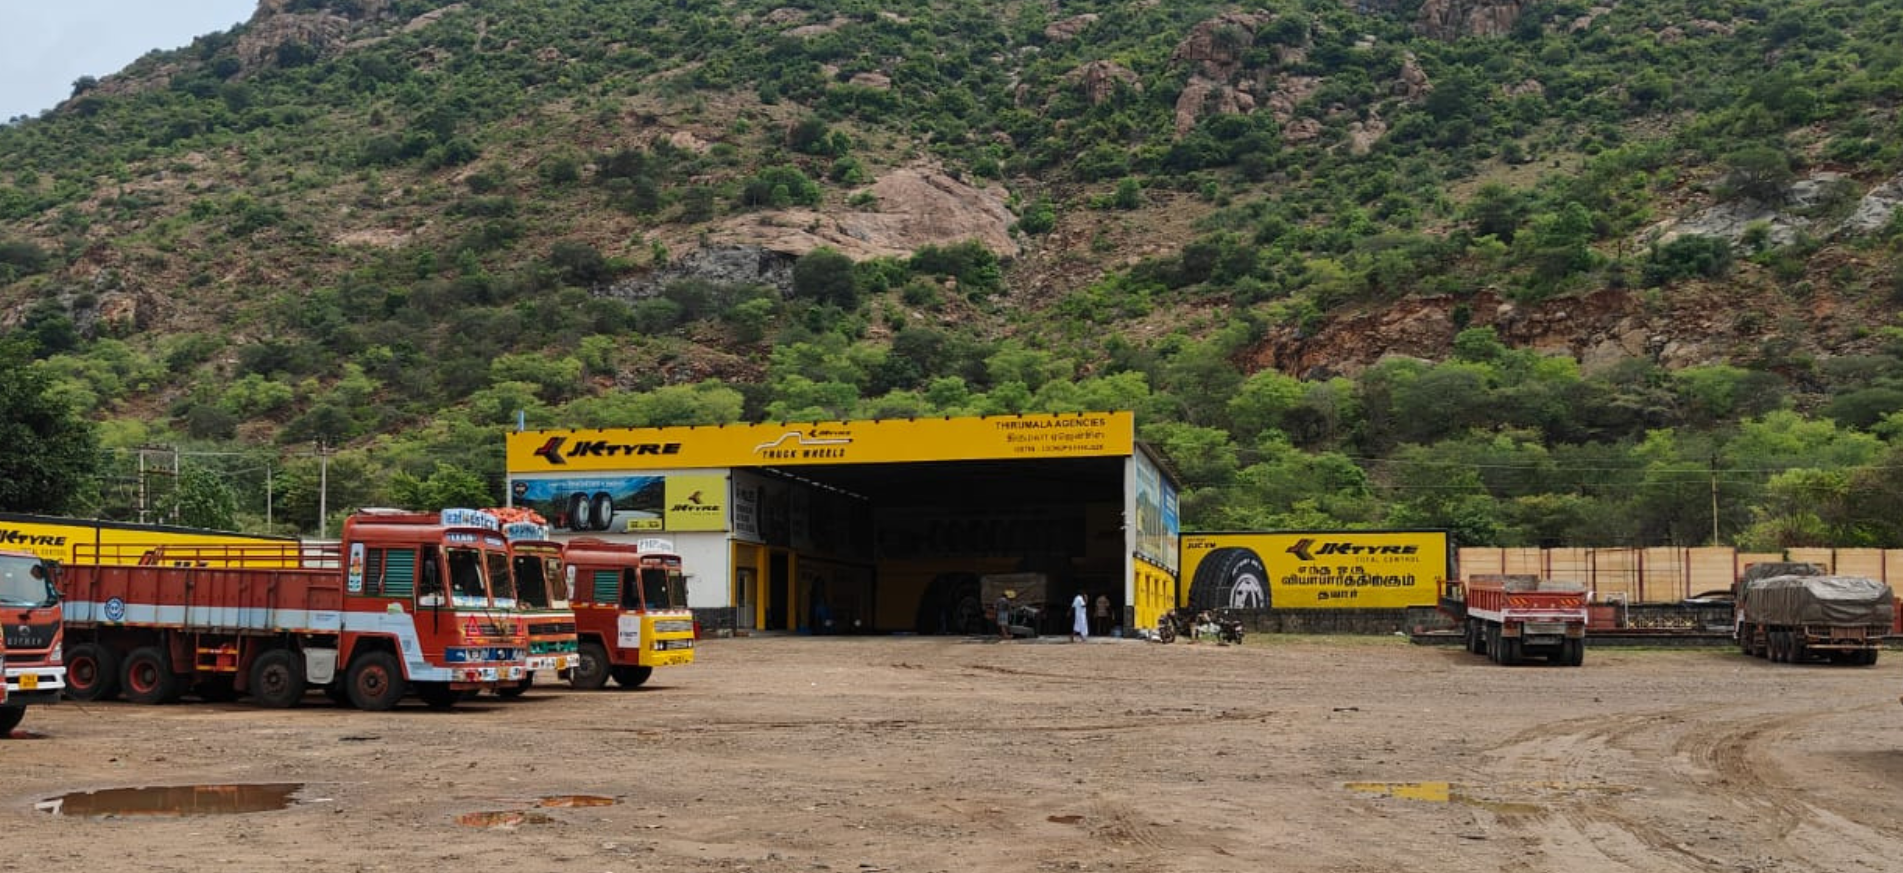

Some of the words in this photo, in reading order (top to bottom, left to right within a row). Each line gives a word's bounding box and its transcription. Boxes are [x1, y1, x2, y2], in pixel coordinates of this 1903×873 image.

[995, 420, 1053, 430] THIRUMALA
[1055, 418, 1106, 428] AGENCIES
[762, 450, 797, 459] TRUCK
